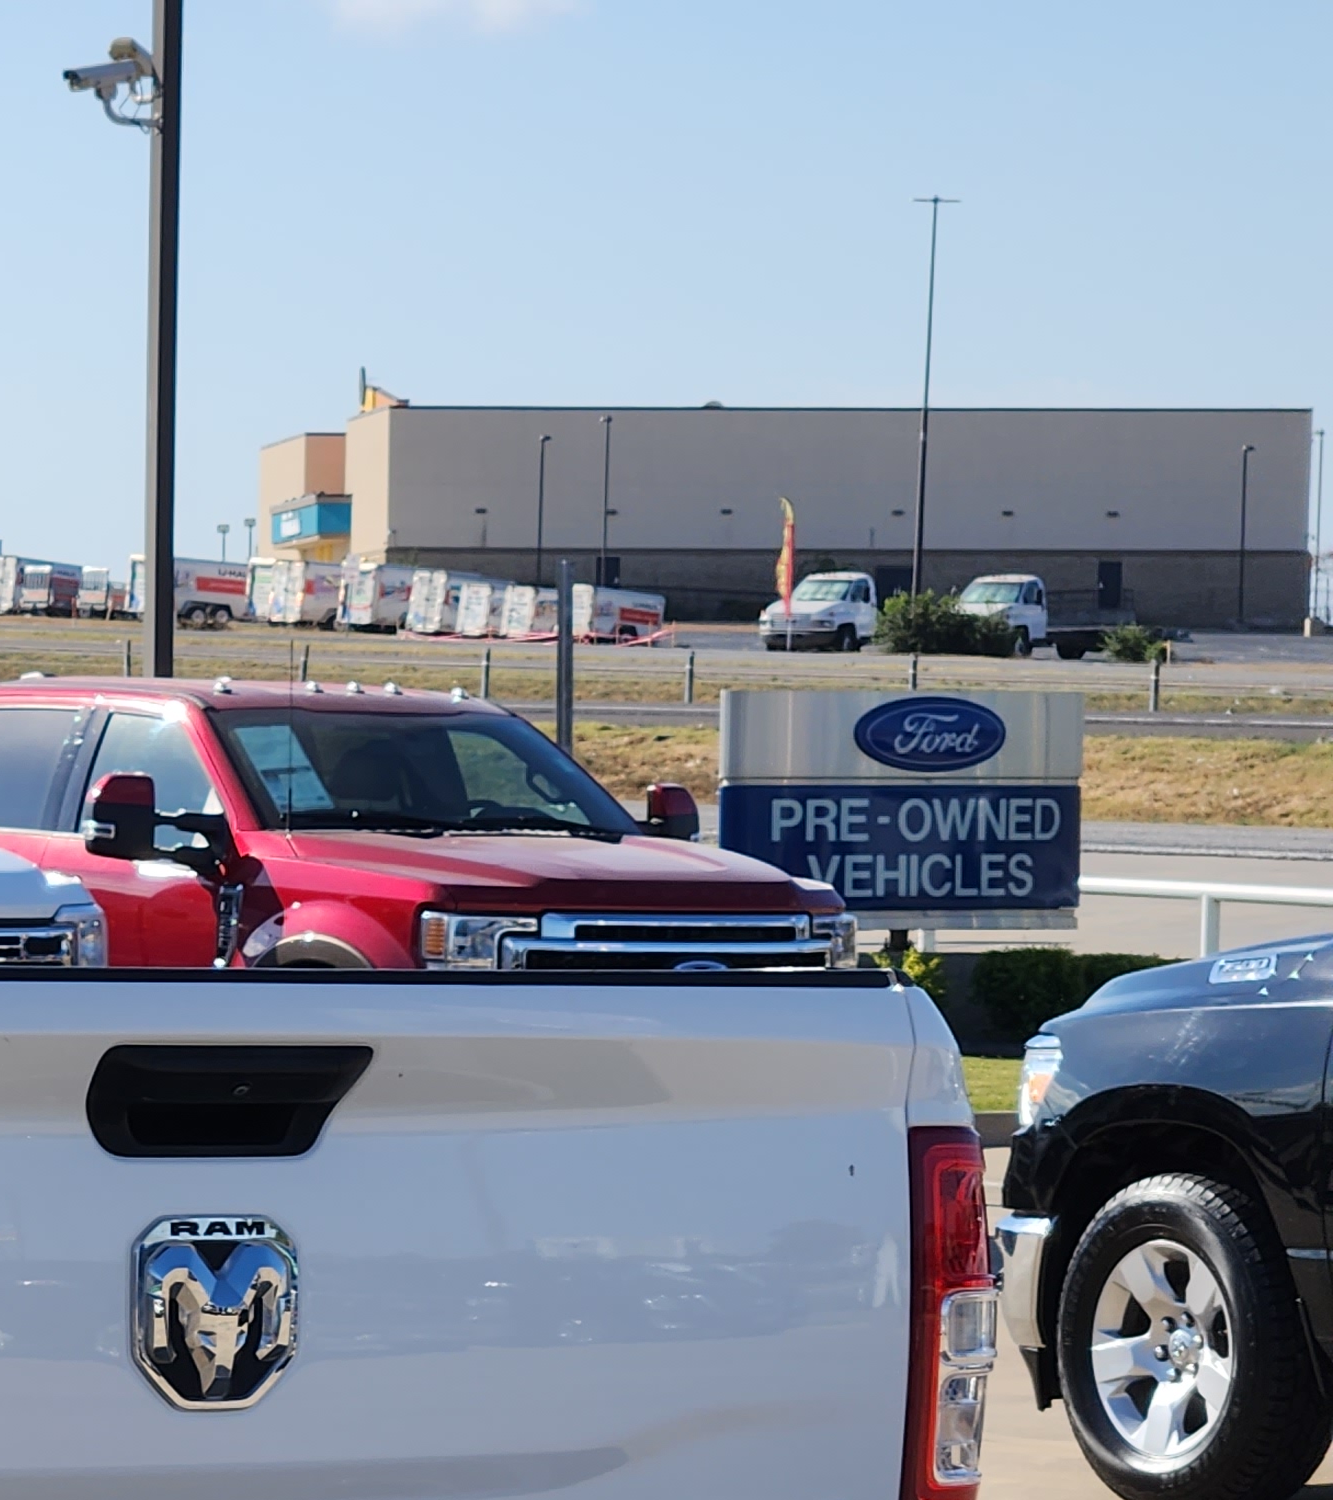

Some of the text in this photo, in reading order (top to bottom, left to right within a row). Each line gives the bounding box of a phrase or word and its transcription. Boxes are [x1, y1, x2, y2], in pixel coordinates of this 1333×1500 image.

[894, 712, 980, 755] Ford
[770, 798, 1061, 842] PRE-OWNED
[806, 853, 1034, 897] VEHICLES
[170, 1221, 265, 1236] RAM
